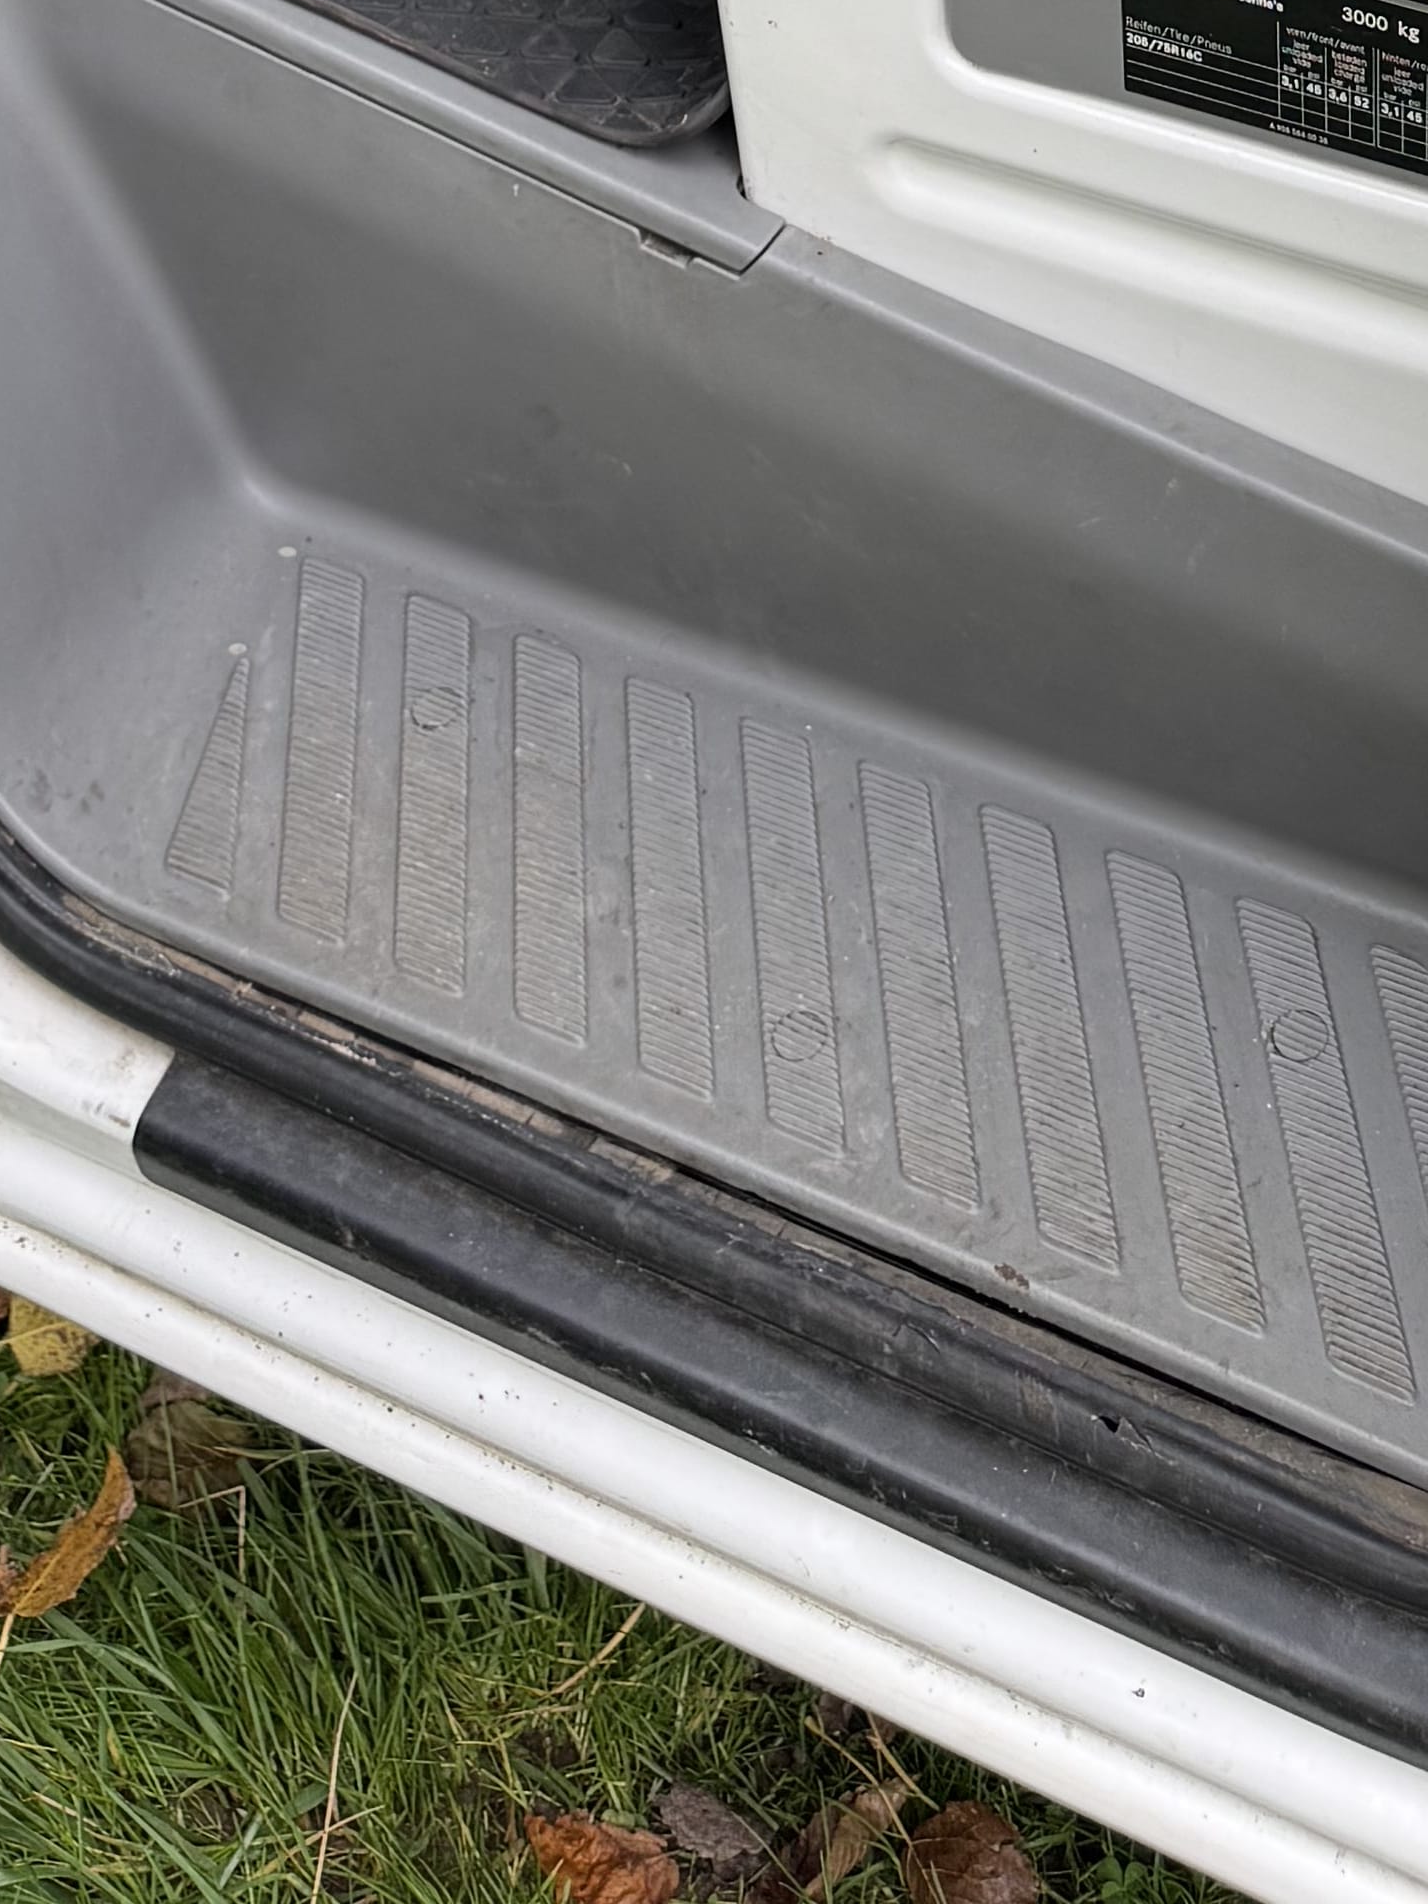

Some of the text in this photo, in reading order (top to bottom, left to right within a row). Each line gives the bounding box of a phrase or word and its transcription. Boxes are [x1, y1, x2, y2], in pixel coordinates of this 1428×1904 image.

[1341, 6, 1420, 44] 3000 kg
[1306, 83, 1322, 95] 45
[1354, 95, 1370, 109] 52
[1406, 110, 1423, 123] 45
